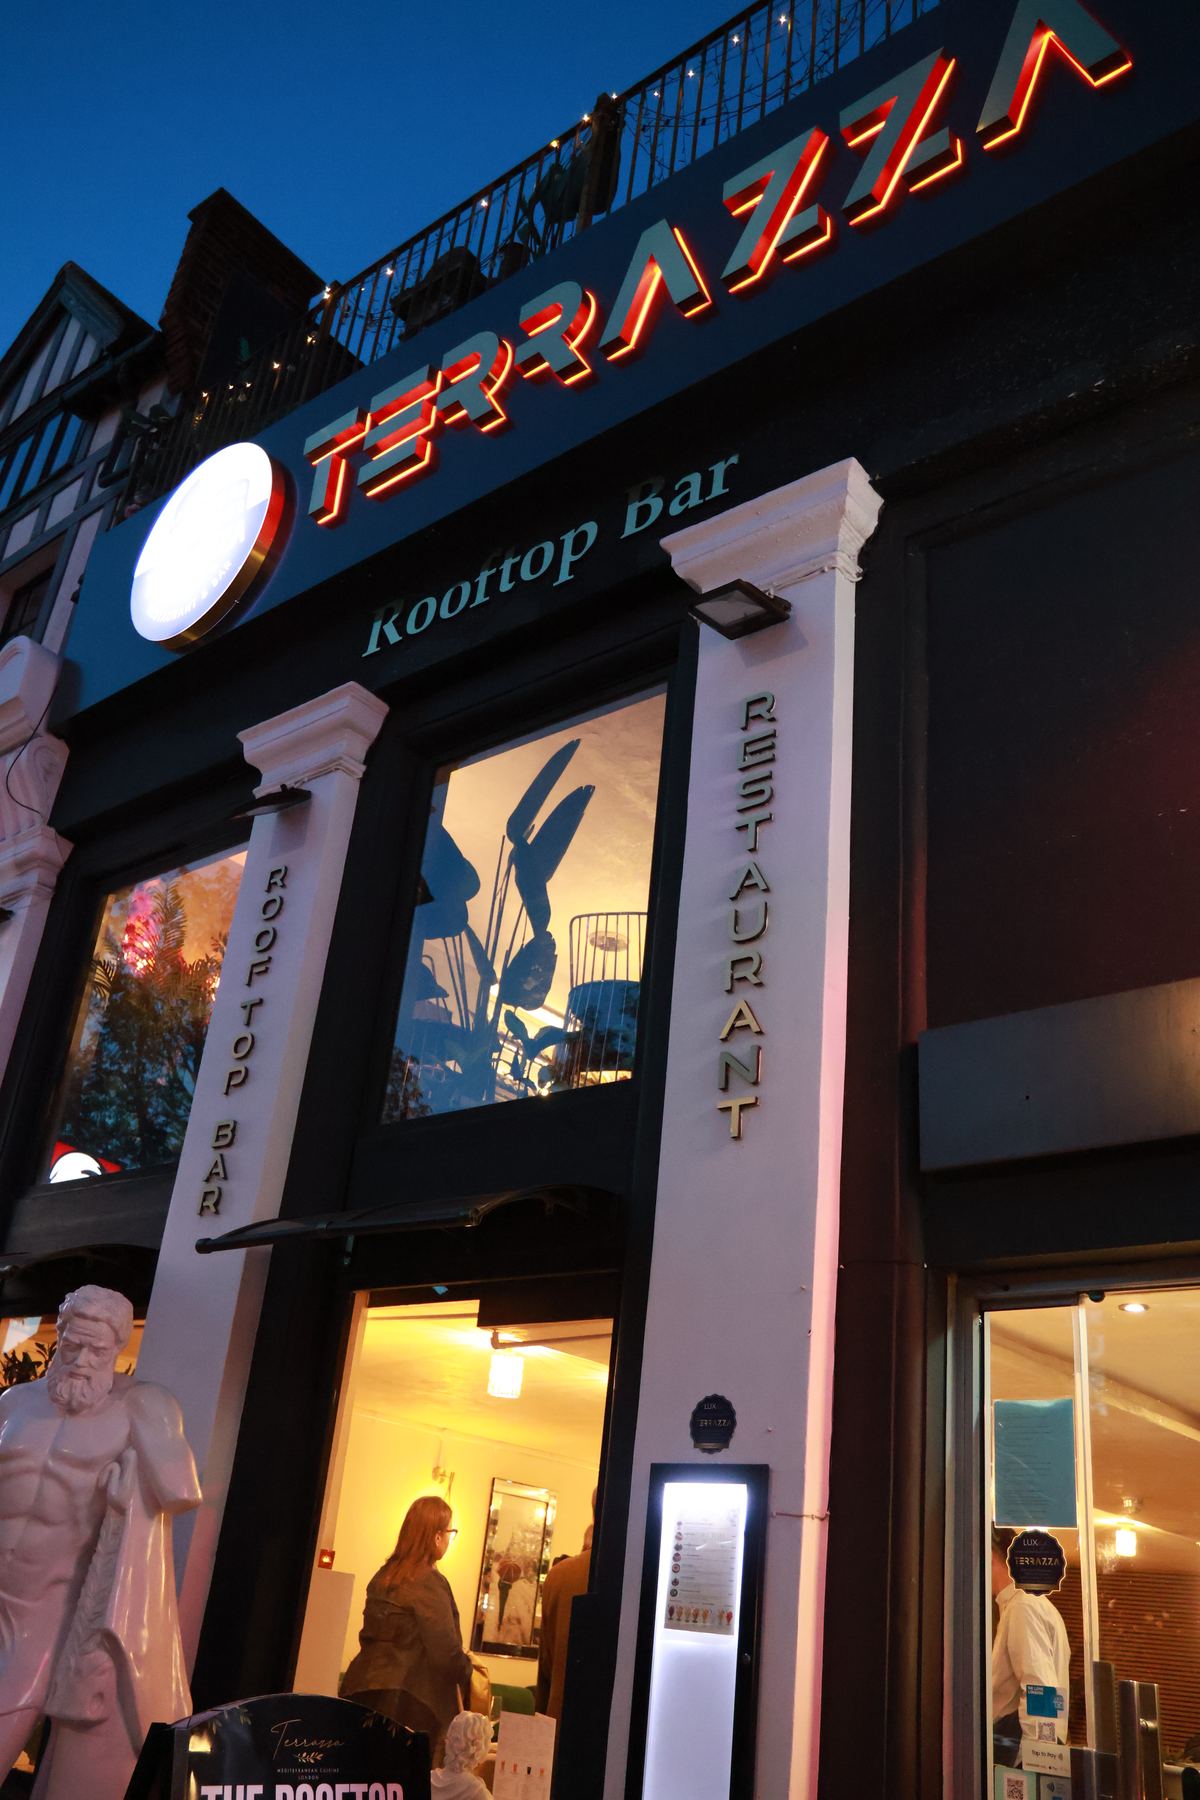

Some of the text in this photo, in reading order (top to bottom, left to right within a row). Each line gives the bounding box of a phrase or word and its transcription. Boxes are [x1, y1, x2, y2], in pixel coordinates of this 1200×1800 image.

[303, 0, 1133, 525] TERRAZZA
[361, 452, 741, 658] Rooftop Bar
[198, 865, 288, 1218] ROOFTOP BAR
[716, 689, 777, 1140] RESTAURANT
[1014, 1556, 1060, 1567] TERRAZZA
